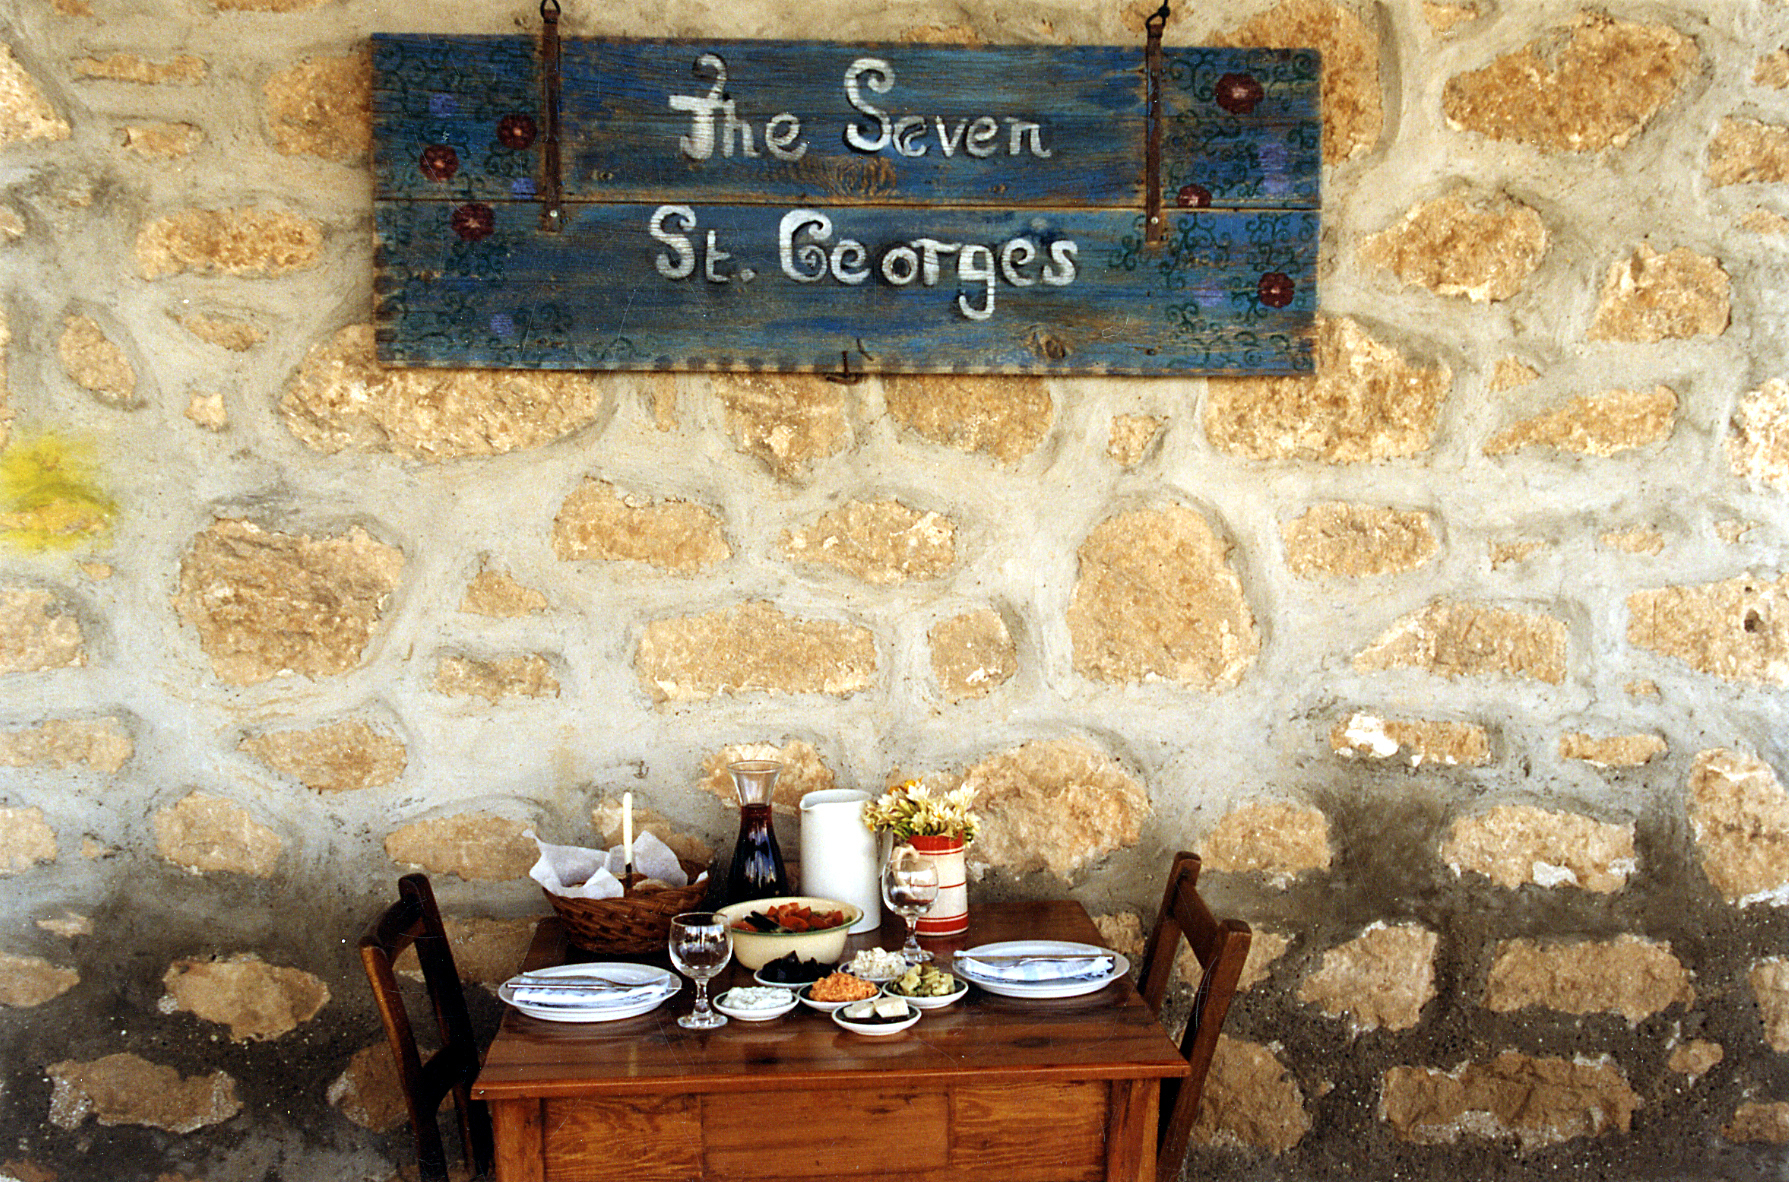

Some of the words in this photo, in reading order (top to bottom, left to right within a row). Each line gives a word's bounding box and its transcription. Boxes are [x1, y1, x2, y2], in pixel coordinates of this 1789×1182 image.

[669, 53, 807, 161] The
[843, 58, 1052, 158] Seven
[649, 205, 756, 282] St.
[779, 208, 1079, 320] Georges
